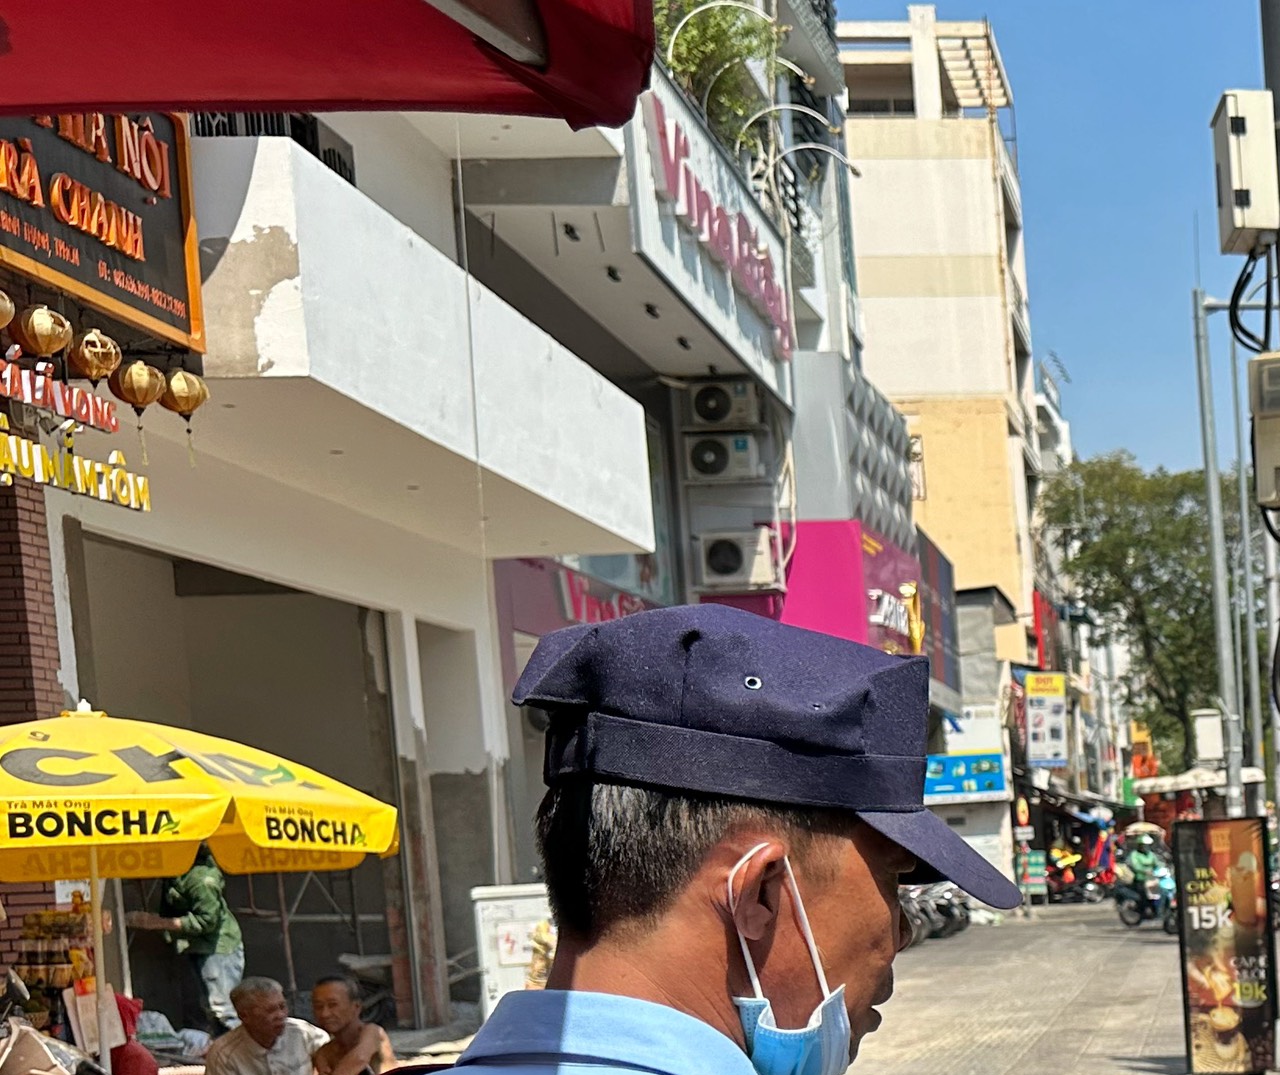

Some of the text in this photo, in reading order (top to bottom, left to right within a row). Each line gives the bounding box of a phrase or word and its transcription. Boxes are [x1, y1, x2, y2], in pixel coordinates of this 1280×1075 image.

[0, 137, 146, 262] RÀ CHANH
[94, 450, 151, 512] TÔM
[7, 809, 180, 839] BONCHA
[265, 816, 367, 847] BONCHA
[1188, 901, 1233, 930] 15k
[1233, 982, 1267, 1001] 19k
